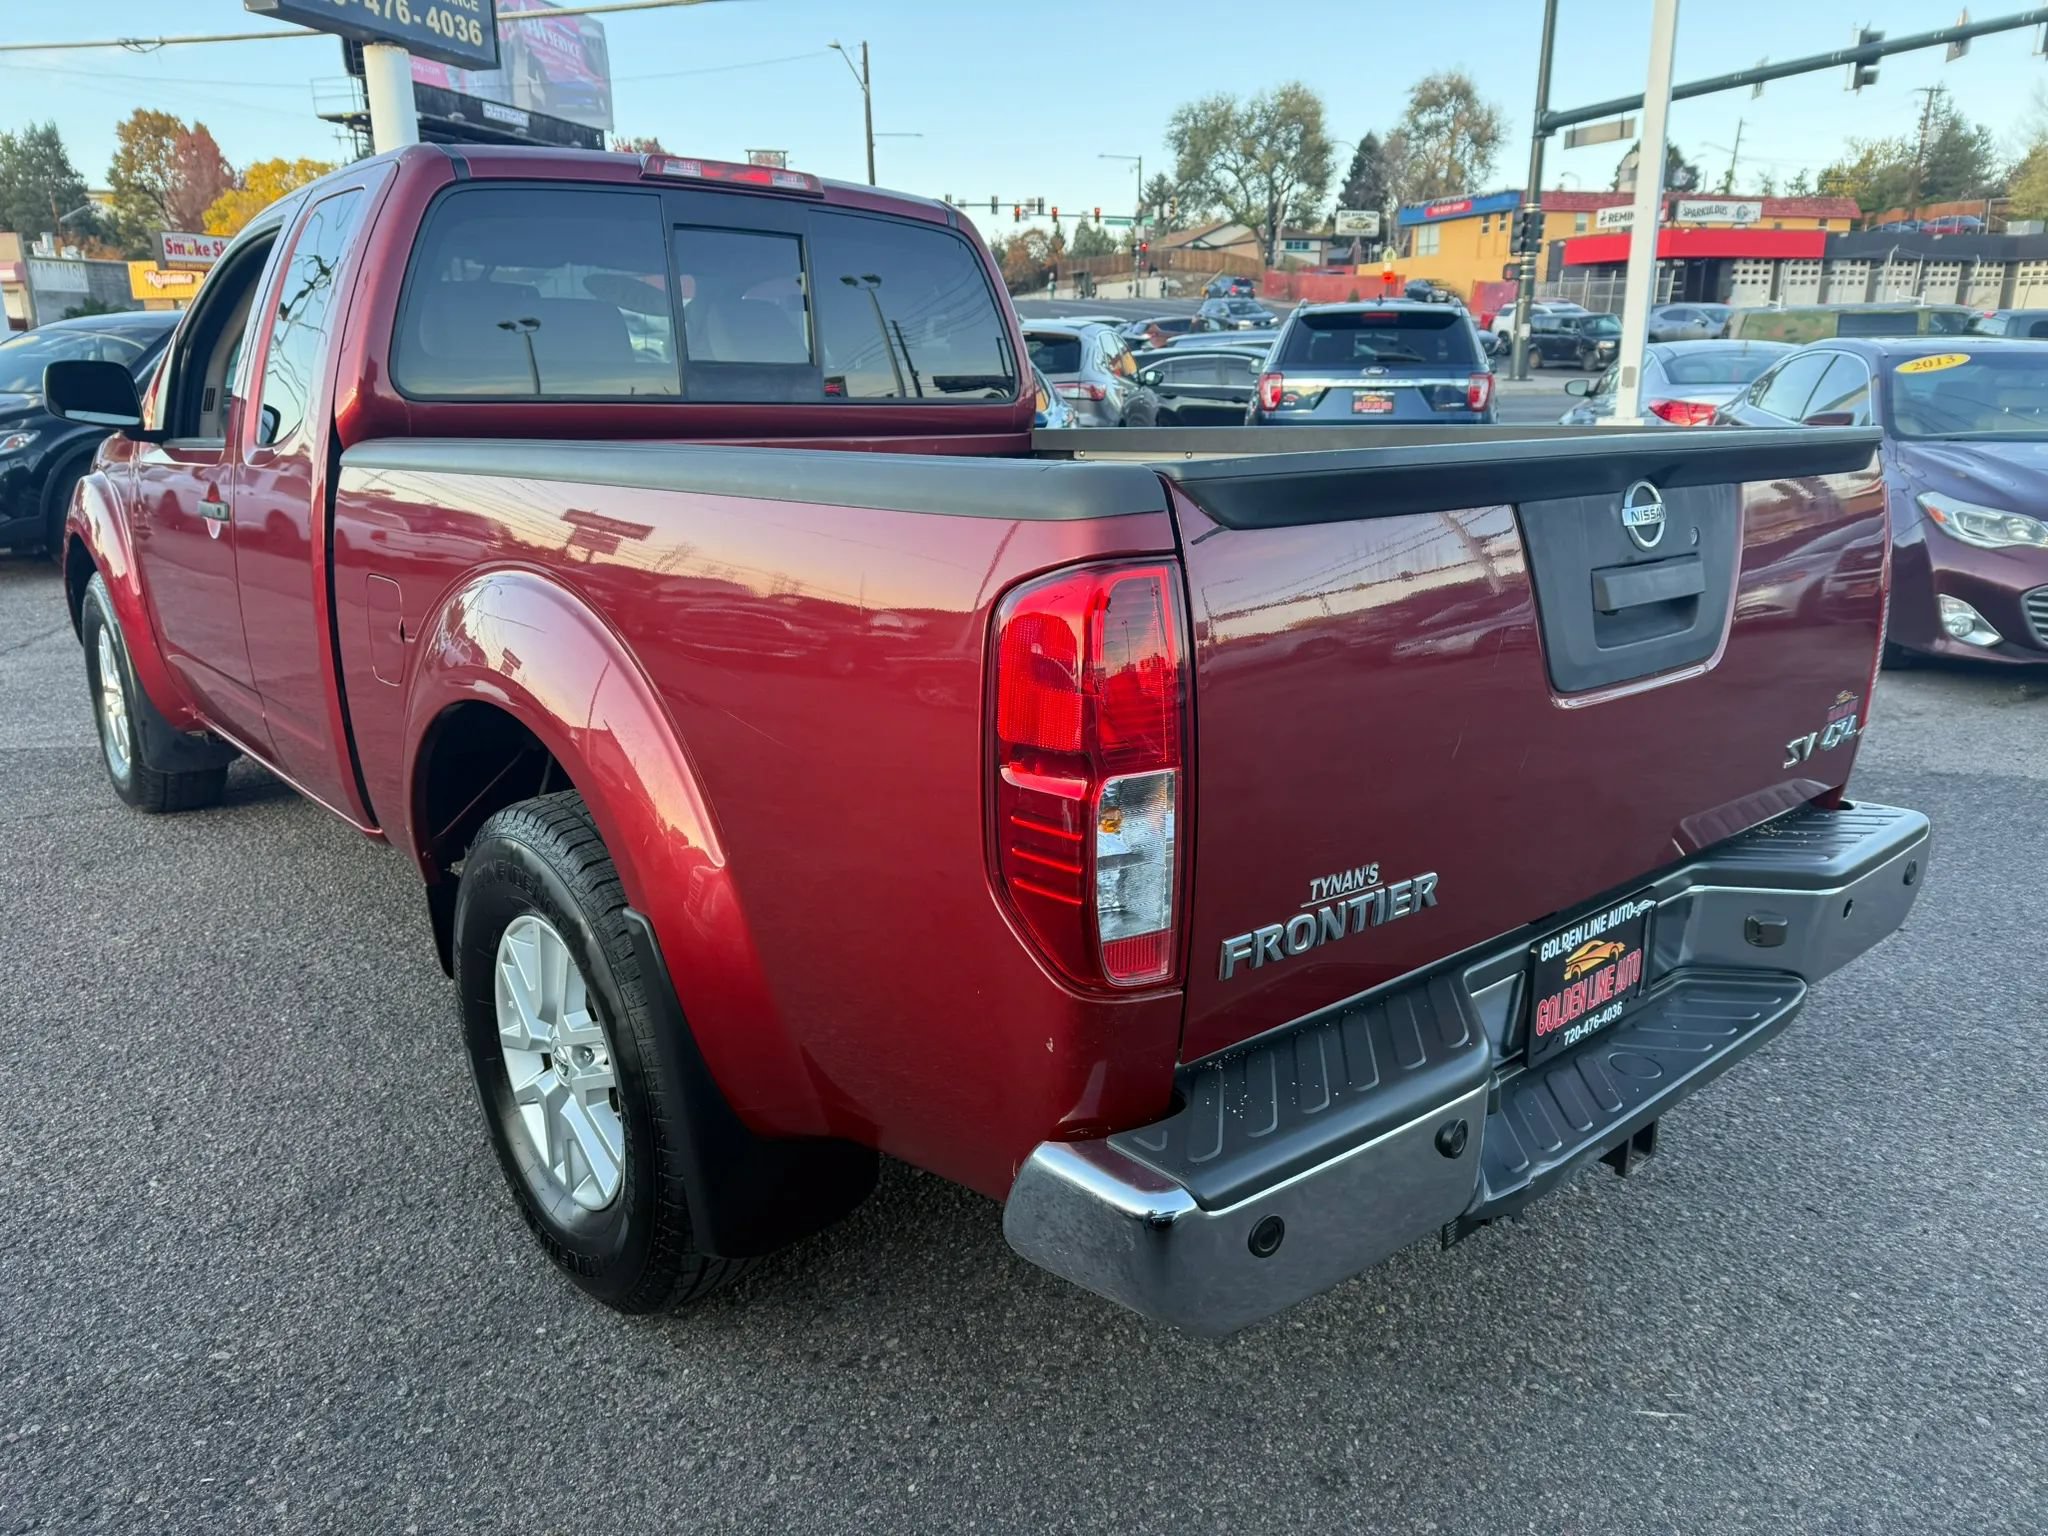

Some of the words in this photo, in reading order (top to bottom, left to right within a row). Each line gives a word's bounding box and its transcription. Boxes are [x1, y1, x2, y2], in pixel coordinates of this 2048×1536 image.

[325, 0, 483, 46] -476-4036
[165, 238, 211, 257] Smoke
[1911, 354, 1956, 371] 2013
[1309, 861, 1380, 901] TYNAN'S
[1218, 871, 1438, 982] FRONTIER
[1541, 926, 1583, 962] GOLDEN
[1584, 914, 1607, 940] LINE
[1608, 902, 1634, 930] AUTO
[1536, 978, 1588, 1037] GOLDEN
[1588, 964, 1616, 1009] LINE
[1614, 948, 1642, 996] AUTO
[1563, 1001, 1623, 1046] 720-476-4036
